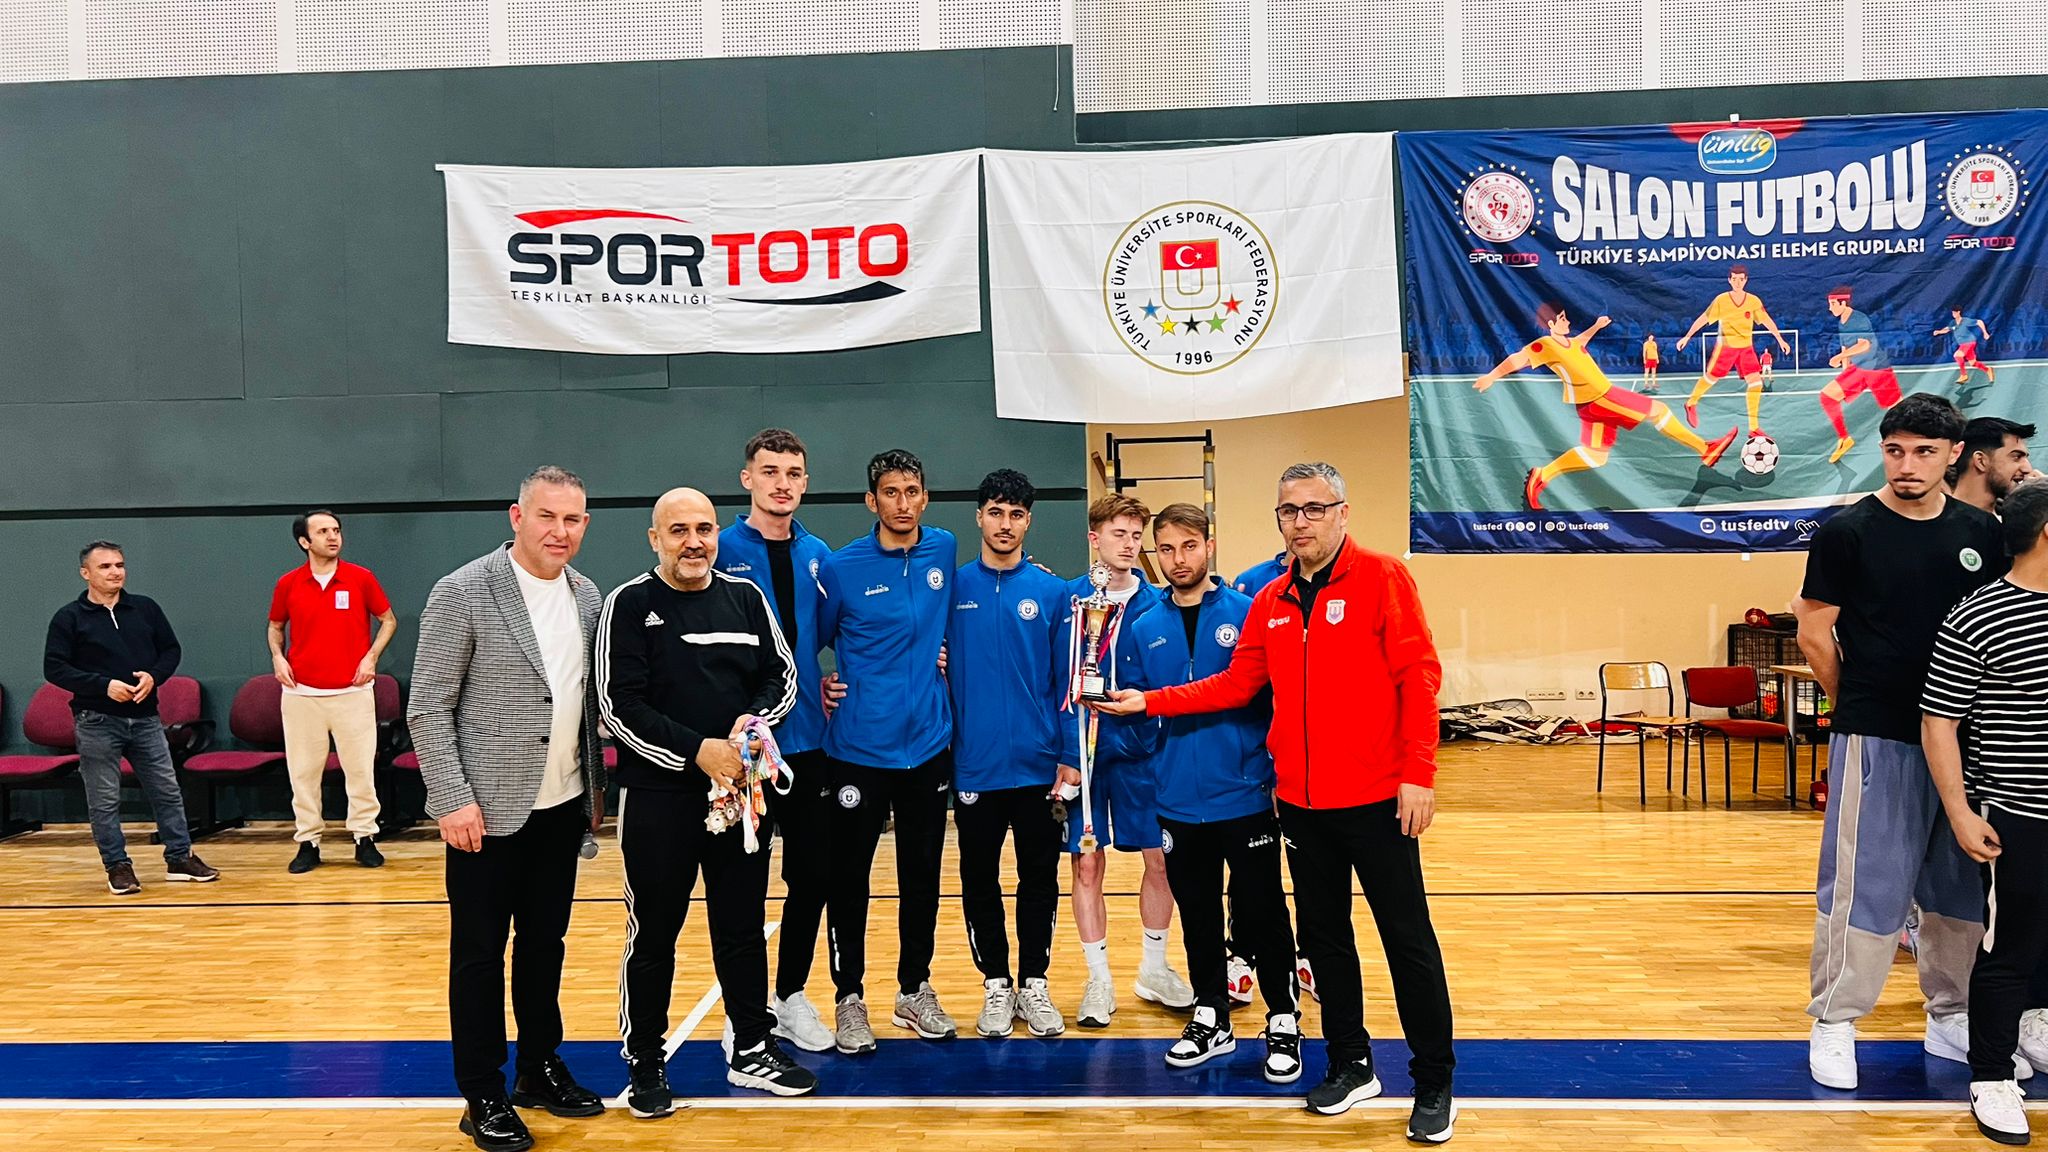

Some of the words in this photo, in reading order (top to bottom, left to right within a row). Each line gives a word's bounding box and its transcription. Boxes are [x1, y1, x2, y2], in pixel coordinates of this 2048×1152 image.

[1552, 155, 1705, 242] SALON
[1717, 139, 1927, 237] FUTBOLU
[1176, 211, 1248, 242] SPORLARI
[1111, 215, 1172, 286] ÜNİVERSİTE
[1555, 244, 1634, 266] TÜRKİYE
[1638, 241, 1766, 267] ŞAMPİYONASI
[1772, 240, 1828, 258] ELEME
[1833, 238, 1925, 256] GRUPLARI
[511, 290, 593, 303] TEŞKİLAT
[602, 293, 707, 305] BAŞKANLIĞI
[1234, 239, 1269, 346] FEDERASYONU
[1114, 291, 1151, 350] TÜRKİYE
[1175, 350, 1213, 365] 1996
[1473, 522, 1503, 531] tusfed
[1568, 521, 1609, 531] tusfed96
[1721, 519, 1789, 531] tusfedtv
